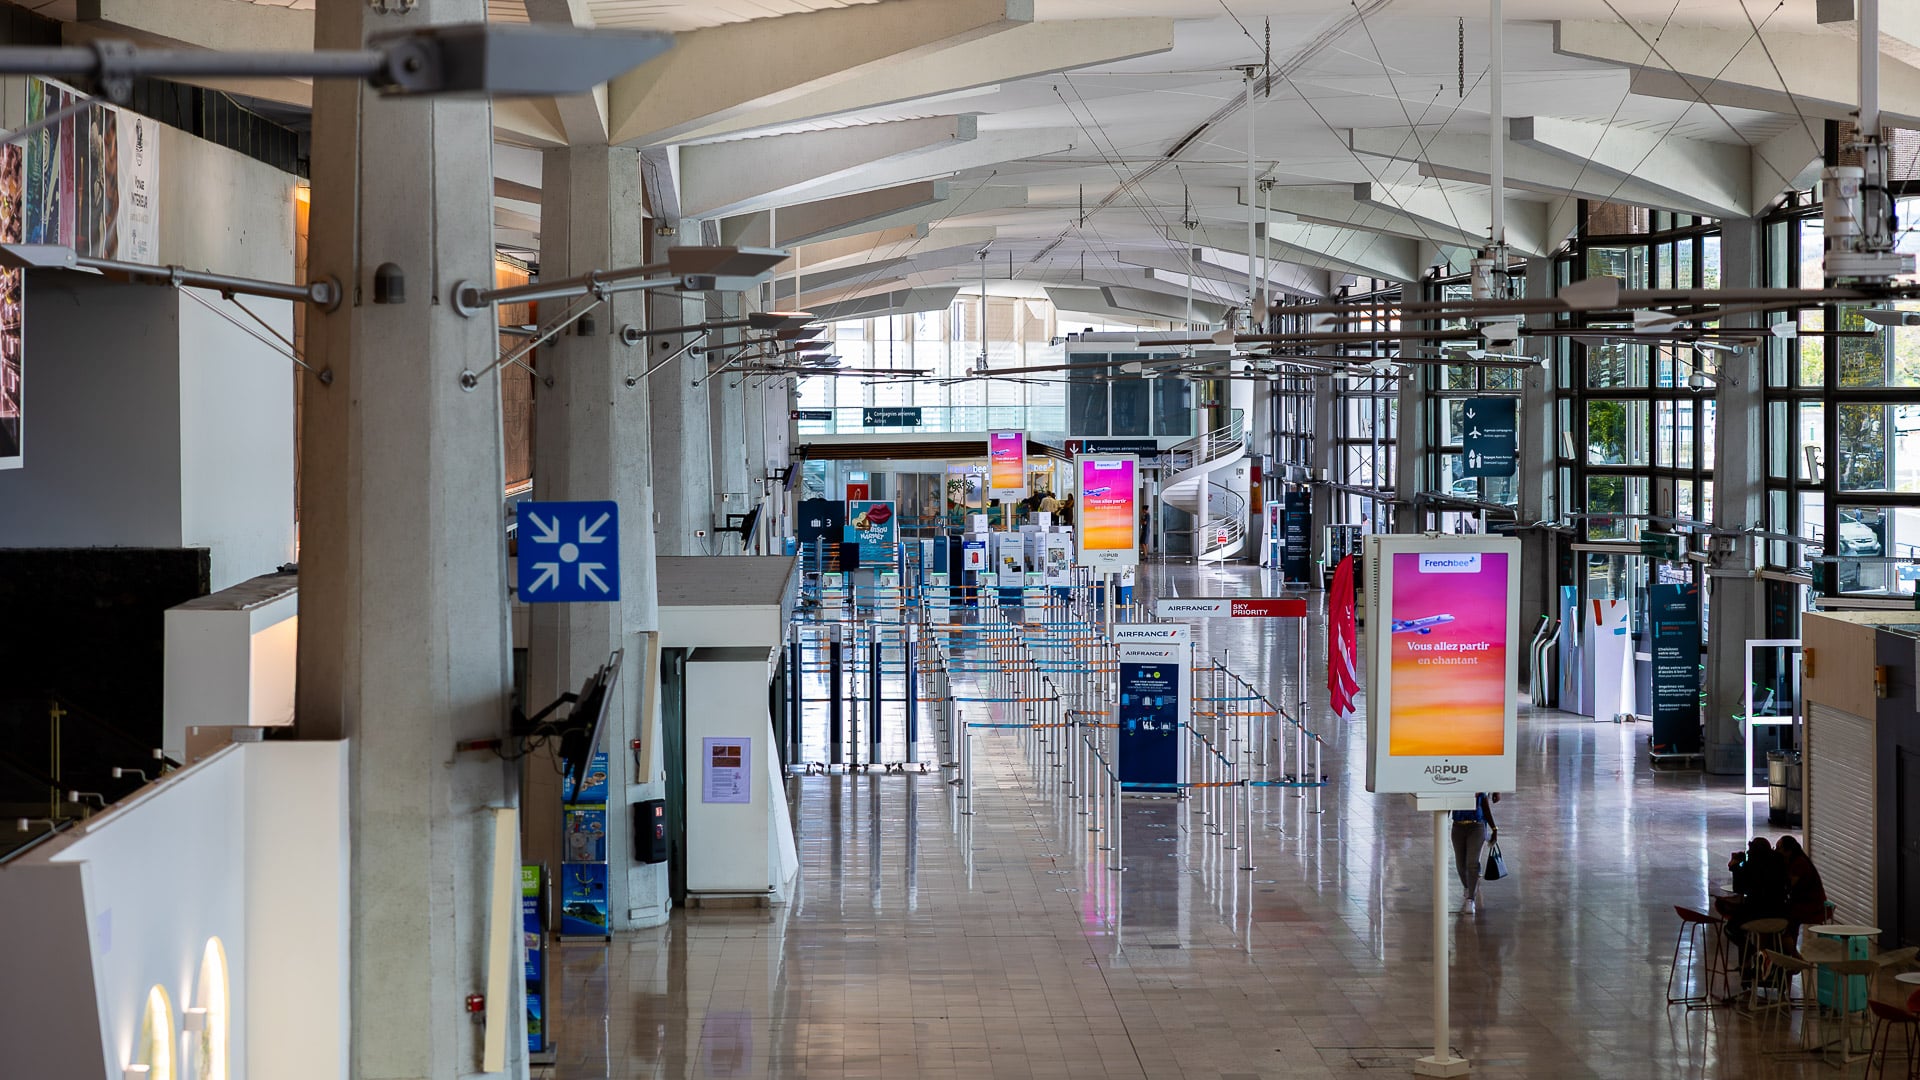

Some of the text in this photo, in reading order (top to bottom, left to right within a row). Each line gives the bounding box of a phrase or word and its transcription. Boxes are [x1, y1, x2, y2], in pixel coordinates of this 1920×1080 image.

[826, 518, 832, 527] 3
[1407, 640, 1490, 652] Vous allez partir
[1418, 655, 1478, 665] en chantant
[1424, 765, 1469, 774] AIRPUB
